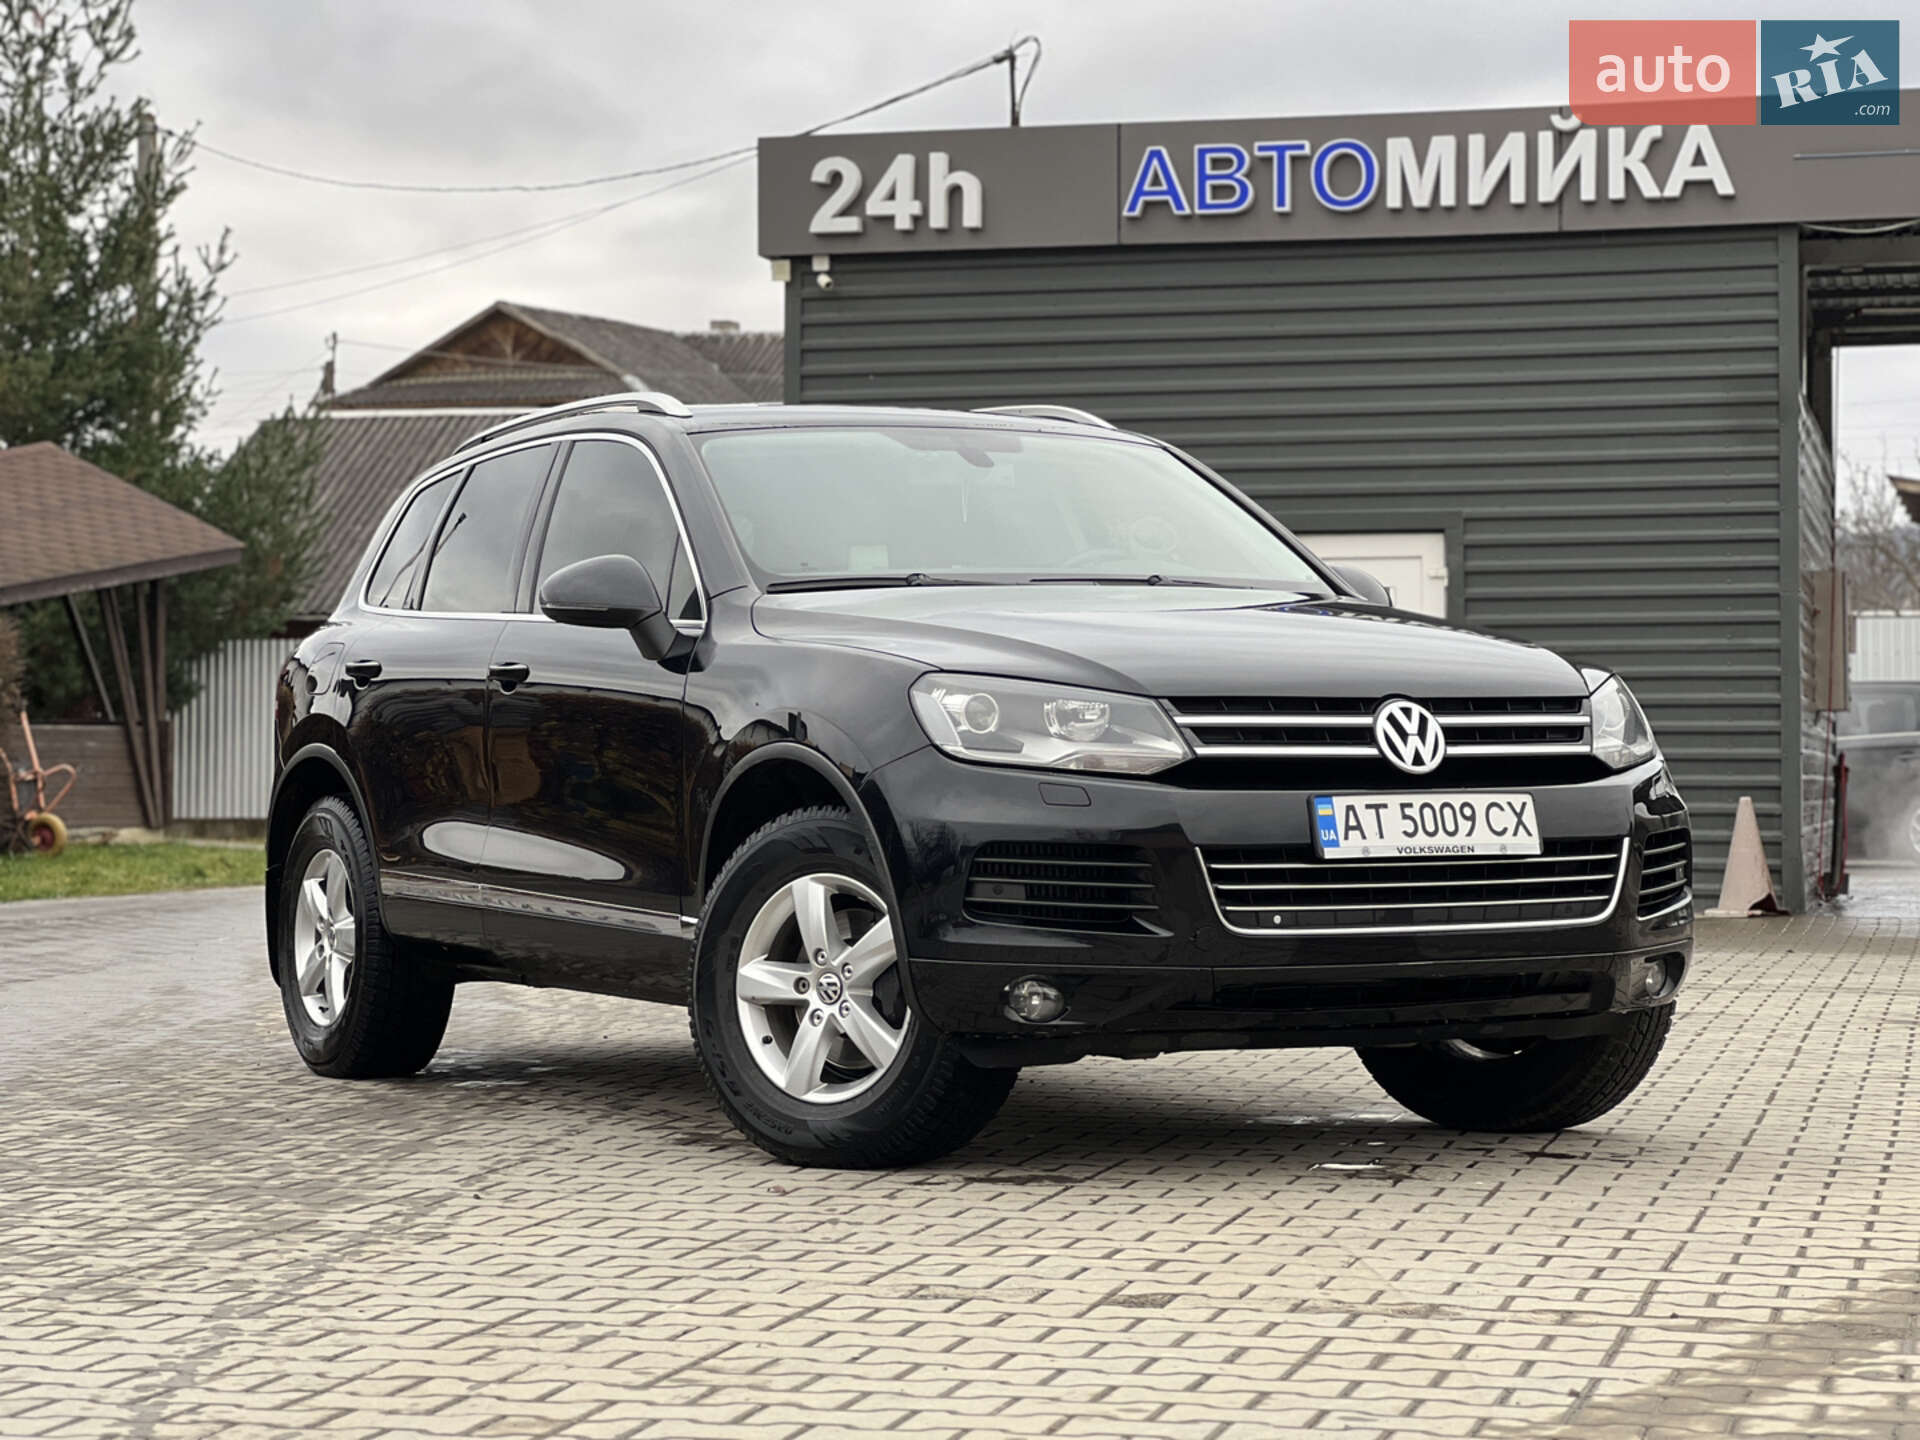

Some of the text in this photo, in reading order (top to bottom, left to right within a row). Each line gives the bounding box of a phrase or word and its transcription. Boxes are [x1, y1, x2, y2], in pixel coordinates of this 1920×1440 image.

[1123, 114, 1736, 218] АВТОМИЙКА
[809, 152, 983, 234] 24h
[1321, 829, 1337, 841] UA
[1343, 801, 1533, 841] AT 5009 CX
[1396, 845, 1475, 855] VOLKSWAGEN
